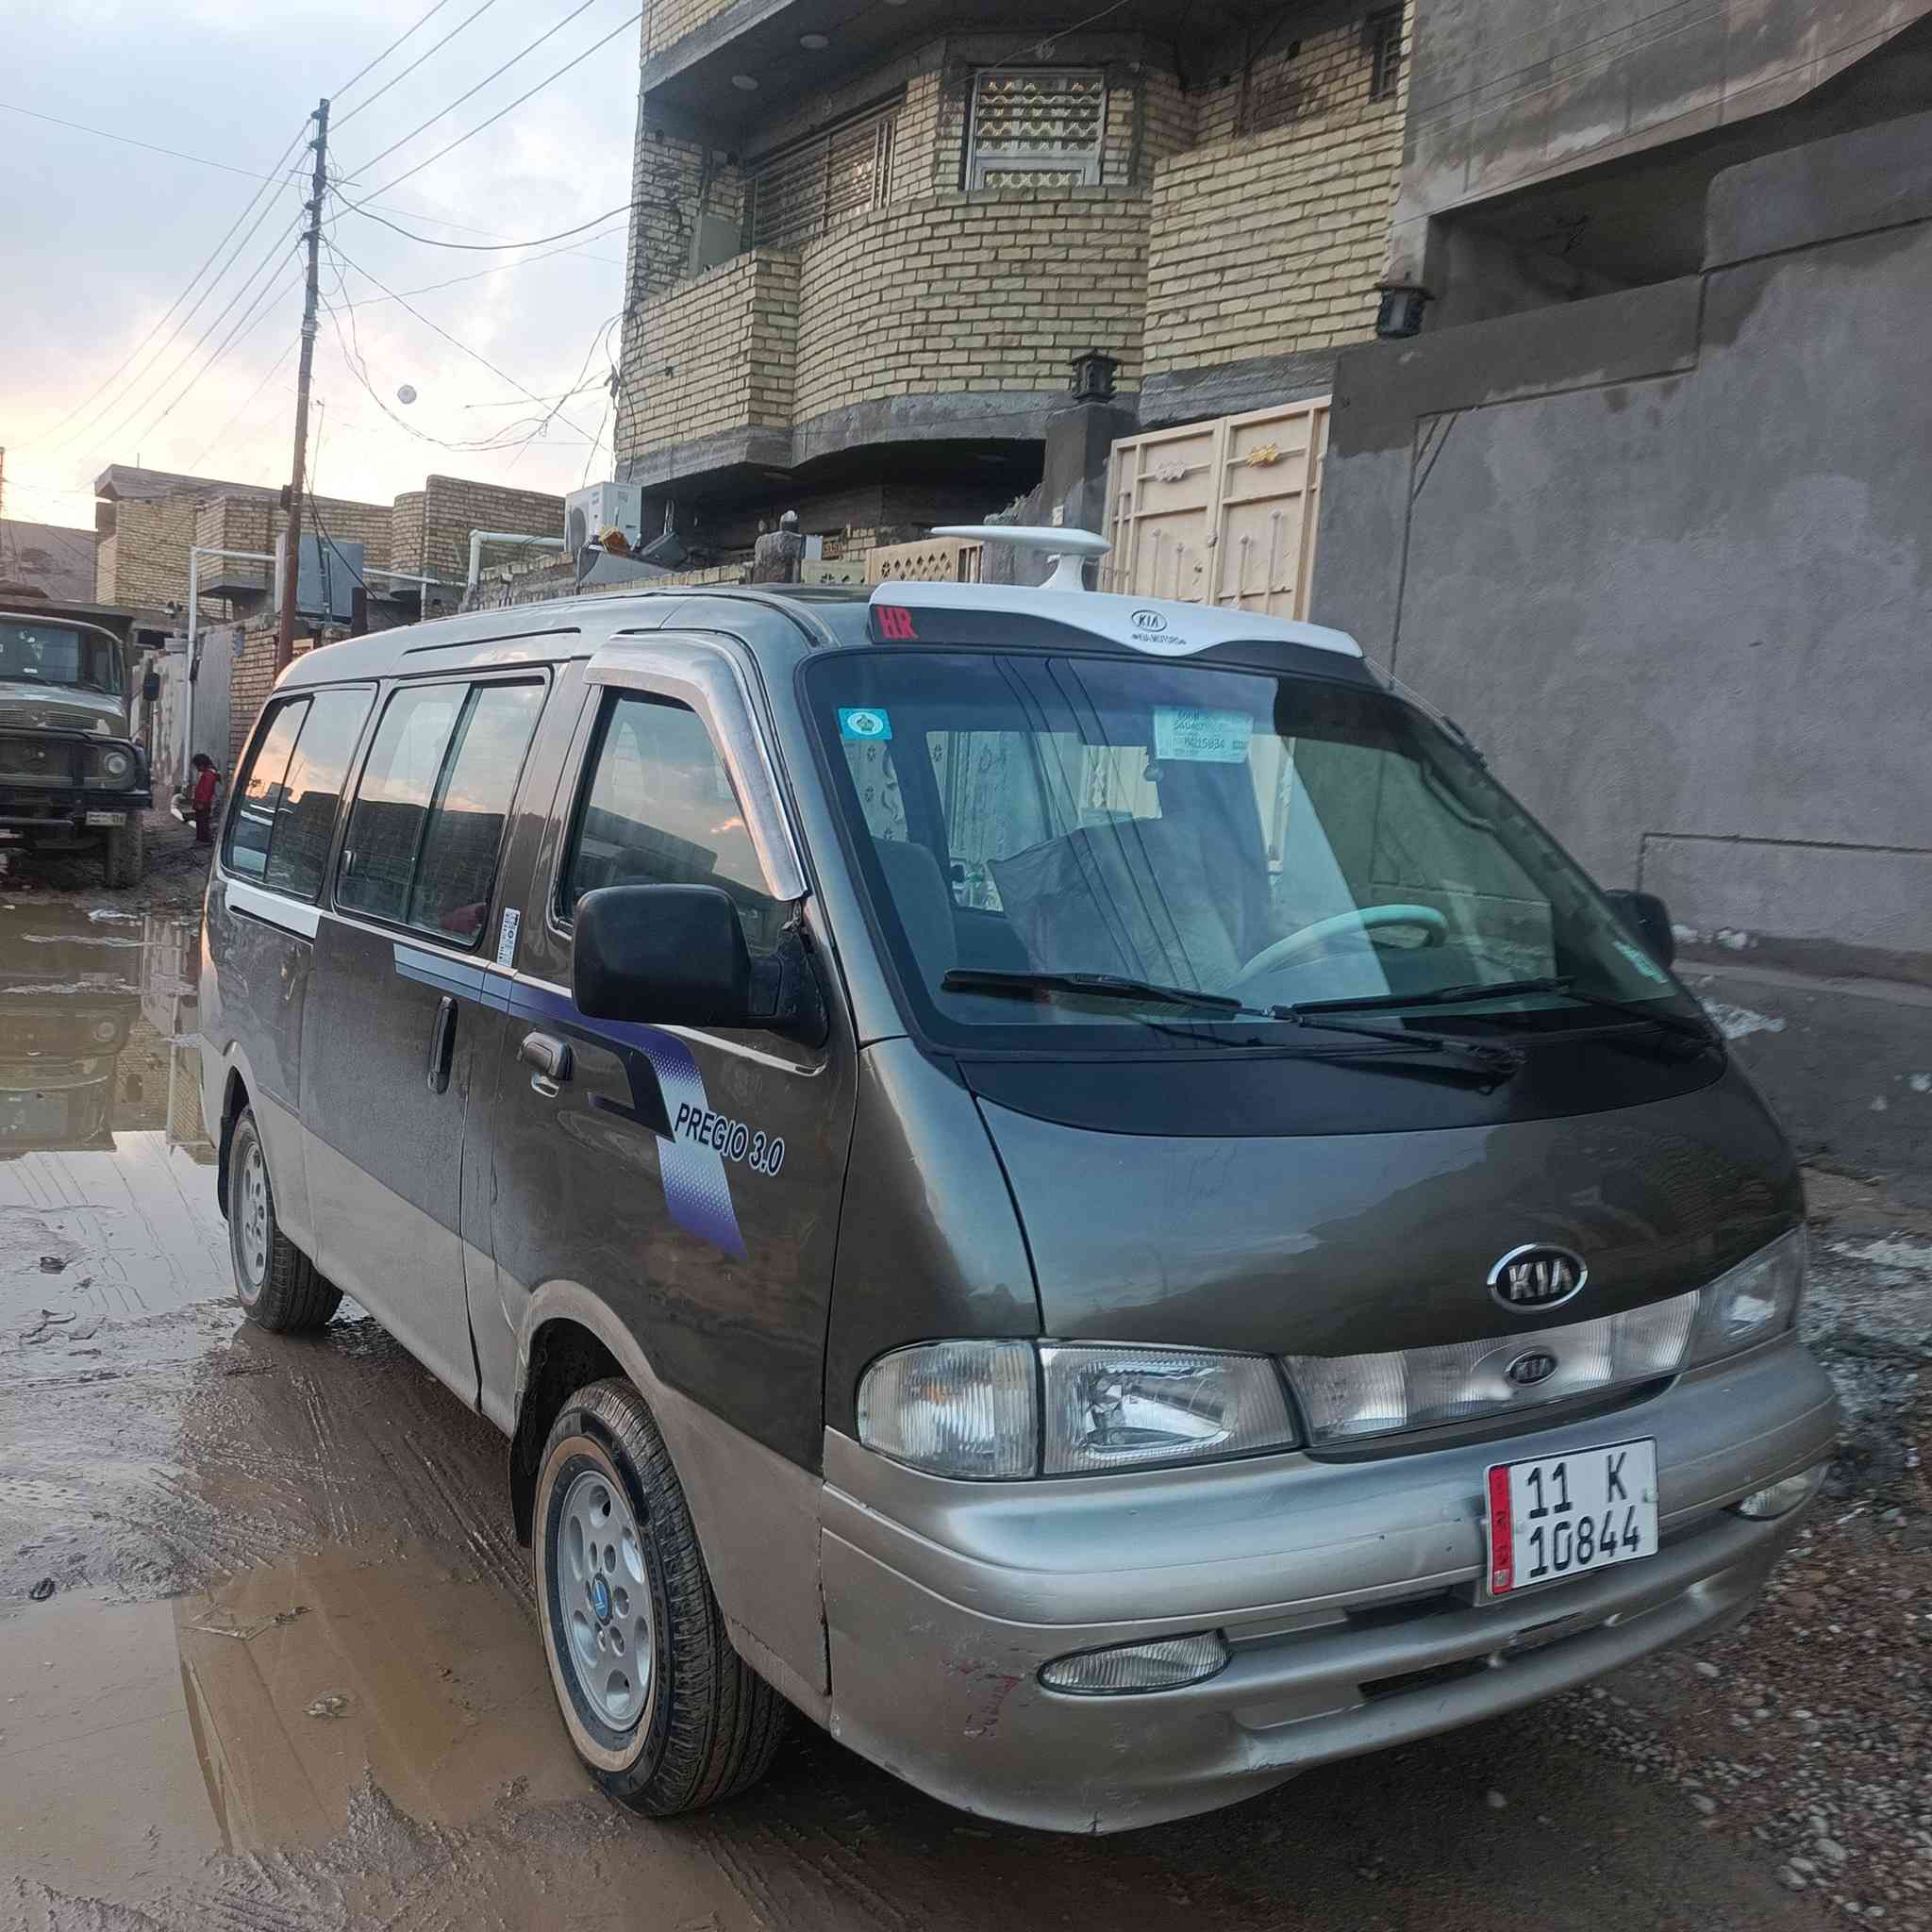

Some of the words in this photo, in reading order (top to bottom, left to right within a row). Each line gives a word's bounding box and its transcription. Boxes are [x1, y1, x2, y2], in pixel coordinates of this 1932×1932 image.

[1138, 613, 1159, 627] KIA
[674, 1101, 749, 1161] PREGIO
[749, 1130, 785, 1176] 3.0
[1508, 1257, 1574, 1301] KIA
[1515, 1357, 1557, 1381] KIA
[1525, 1461, 1574, 1520] 11
[1607, 1451, 1629, 1504] K
[1528, 1505, 1641, 1578] 10844
